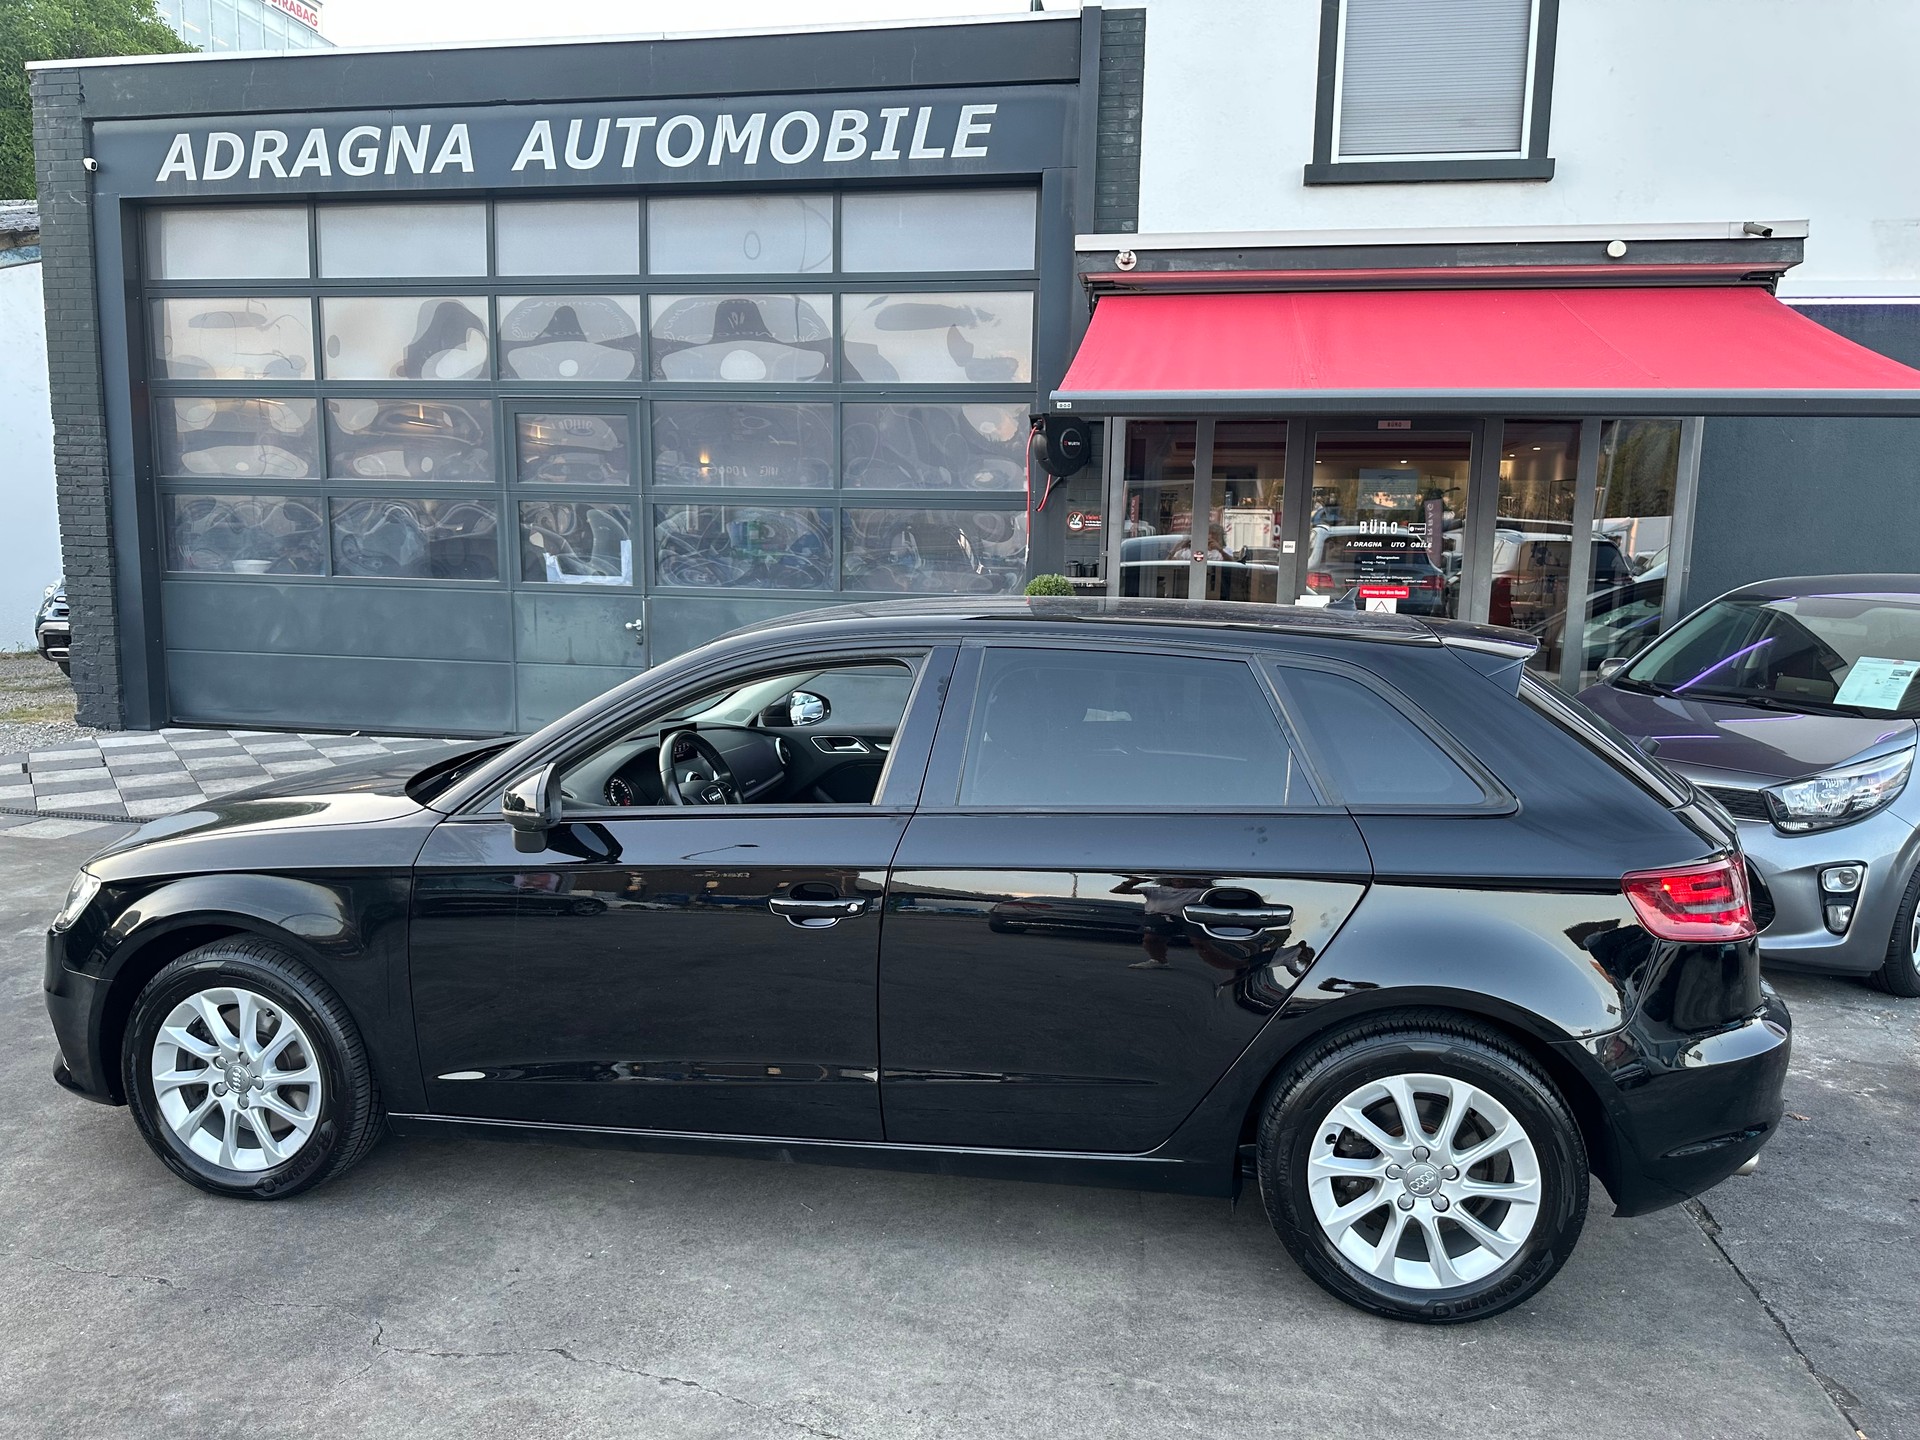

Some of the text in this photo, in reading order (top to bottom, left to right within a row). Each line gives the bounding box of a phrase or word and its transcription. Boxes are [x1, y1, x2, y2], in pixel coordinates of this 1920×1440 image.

[271, 0, 318, 27] RABAG
[156, 104, 998, 182] ADRAGNA AUTOMOBILE
[1360, 519, 1398, 535] BÜRO
